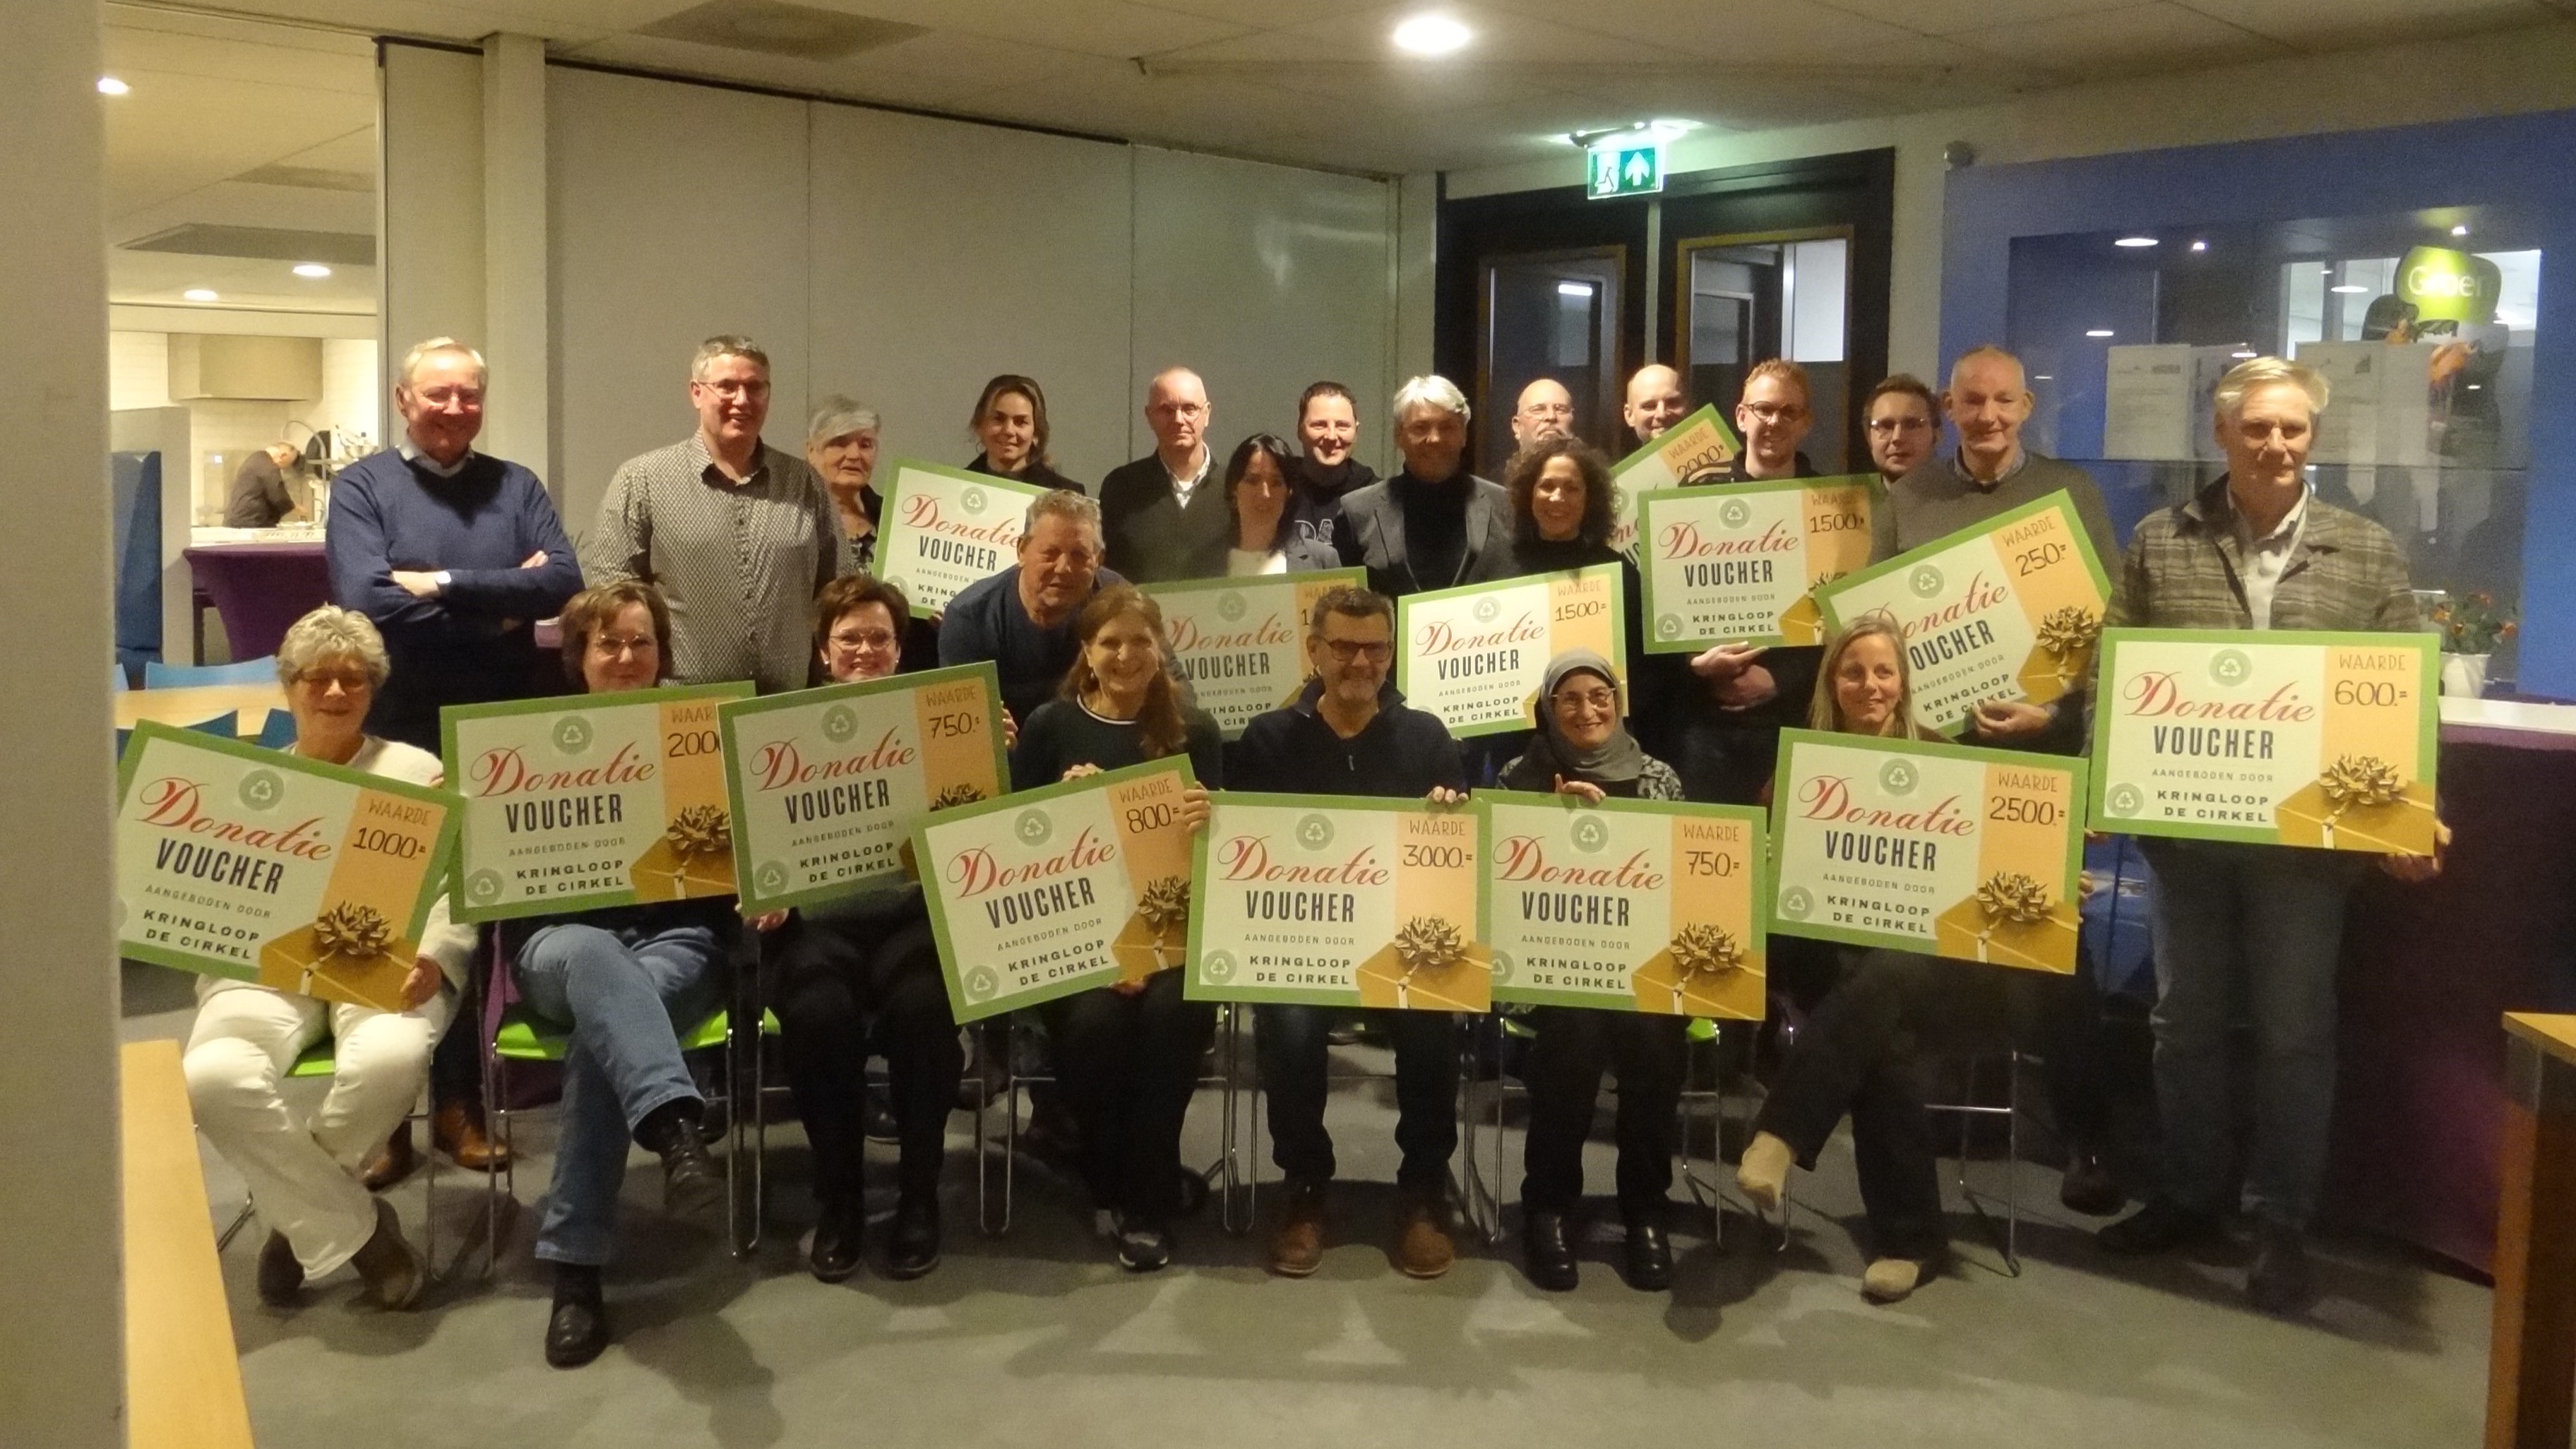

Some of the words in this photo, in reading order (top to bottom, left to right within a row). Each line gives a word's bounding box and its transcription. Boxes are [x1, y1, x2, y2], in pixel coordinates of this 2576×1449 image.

[1667, 427, 1709, 459] WAARDE
[902, 494, 1018, 548] Donatie
[2001, 516, 2055, 547] WAARDE
[1659, 518, 1799, 558] Donatie
[920, 535, 997, 571] VOUCHER
[916, 567, 969, 583] AANGEBODEN
[1685, 559, 1772, 586] VOUCHER
[918, 583, 956, 597] KRING
[922, 597, 936, 605] DE
[1558, 580, 1600, 597] WAARDE
[1693, 612, 1773, 622] KRINGLOOP
[1724, 624, 1773, 633] CIRKEL
[1167, 612, 1293, 652] Donatie
[1416, 610, 1544, 655] Donatie
[1909, 619, 1995, 670] OUCHER
[1185, 652, 1270, 680] VOUCHER
[1438, 648, 1519, 680] VOUCHER
[2339, 654, 2405, 670] WAARDE
[926, 686, 977, 708] WAARDE
[1444, 696, 1517, 712] KRINGLOOP
[1923, 673, 2008, 712] KRINGLOOP
[1936, 710, 1954, 722] DE
[1961, 688, 2016, 713] CRKEL
[2124, 672, 2314, 721] Donatie
[672, 706, 714, 723] WAAR
[1205, 703, 1271, 715] RINGLOOP
[1224, 717, 1247, 726] CIR
[1472, 709, 1517, 720] CIRKEL
[2154, 725, 2274, 759] VOUCHER
[470, 740, 655, 796] Donatie
[750, 725, 915, 790] Donatie
[1999, 771, 2058, 792] WAARDE
[2152, 768, 2233, 780] AANGEBODEN
[2241, 773, 2273, 782] DOOR
[785, 778, 890, 824] VOUCHER
[1118, 779, 1172, 804] WAARDE
[1799, 775, 1974, 835] Donatie
[2157, 790, 2268, 805] KRINGLOOP
[135, 778, 330, 860] Donatie
[369, 799, 431, 826] WAARDE
[506, 793, 622, 833] VOUCHER
[2165, 807, 2186, 816] DE
[2198, 809, 2266, 821] CIRKEL
[1409, 819, 1465, 835] WAARDE
[1684, 823, 1739, 841] WAARDE
[509, 841, 587, 857] AANGEBODEN
[595, 837, 625, 847] DOOR
[800, 842, 893, 869] KRINGLOOP
[1218, 835, 1389, 885] Donatie
[1826, 830, 1937, 871] VOUCHER
[156, 838, 285, 895] VOUCHER
[517, 859, 622, 879] KRINGLOOP
[809, 871, 828, 883] DE
[837, 858, 895, 876] CIRKEL
[946, 824, 1115, 898] Donatie
[1493, 835, 1664, 889] Donatie
[526, 884, 547, 895] DE
[558, 876, 623, 891] CIRKEL
[1823, 873, 1897, 889] AANGEBODEN
[1904, 883, 1934, 894] DOOR
[145, 885, 231, 910] AANGEBODEN
[237, 904, 271, 919] DOOR
[984, 876, 1095, 929] VOUCHER
[1246, 890, 1354, 922] VOUCHER
[1522, 890, 1629, 926] VOUCHER
[1827, 895, 1929, 916] KRINGLOOP
[143, 909, 259, 941] KRINGLOOP
[998, 926, 1068, 951] AANGEBODEN
[1074, 917, 1102, 931] DOOR
[1834, 912, 1853, 923] DE
[1864, 917, 1926, 932] CIRKEL
[145, 929, 170, 942] DE
[182, 936, 250, 959] CIRKEL
[1245, 934, 1318, 943] AANGEBODEN
[1522, 935, 1594, 947] AANGEBODEN
[1602, 941, 1630, 949] DOOR
[1008, 939, 1104, 972] KRINGLOOP
[1250, 955, 1349, 968] KRINGLOOP
[1527, 957, 1626, 972] KRINGLOOP
[1020, 973, 1039, 986] DE
[1048, 955, 1108, 977] CIRKEL
[1257, 972, 1276, 982] DE
[1287, 974, 1348, 984] CIRKEL
[1534, 974, 1553, 984] DE
[1563, 977, 1624, 989] CIRKEL
